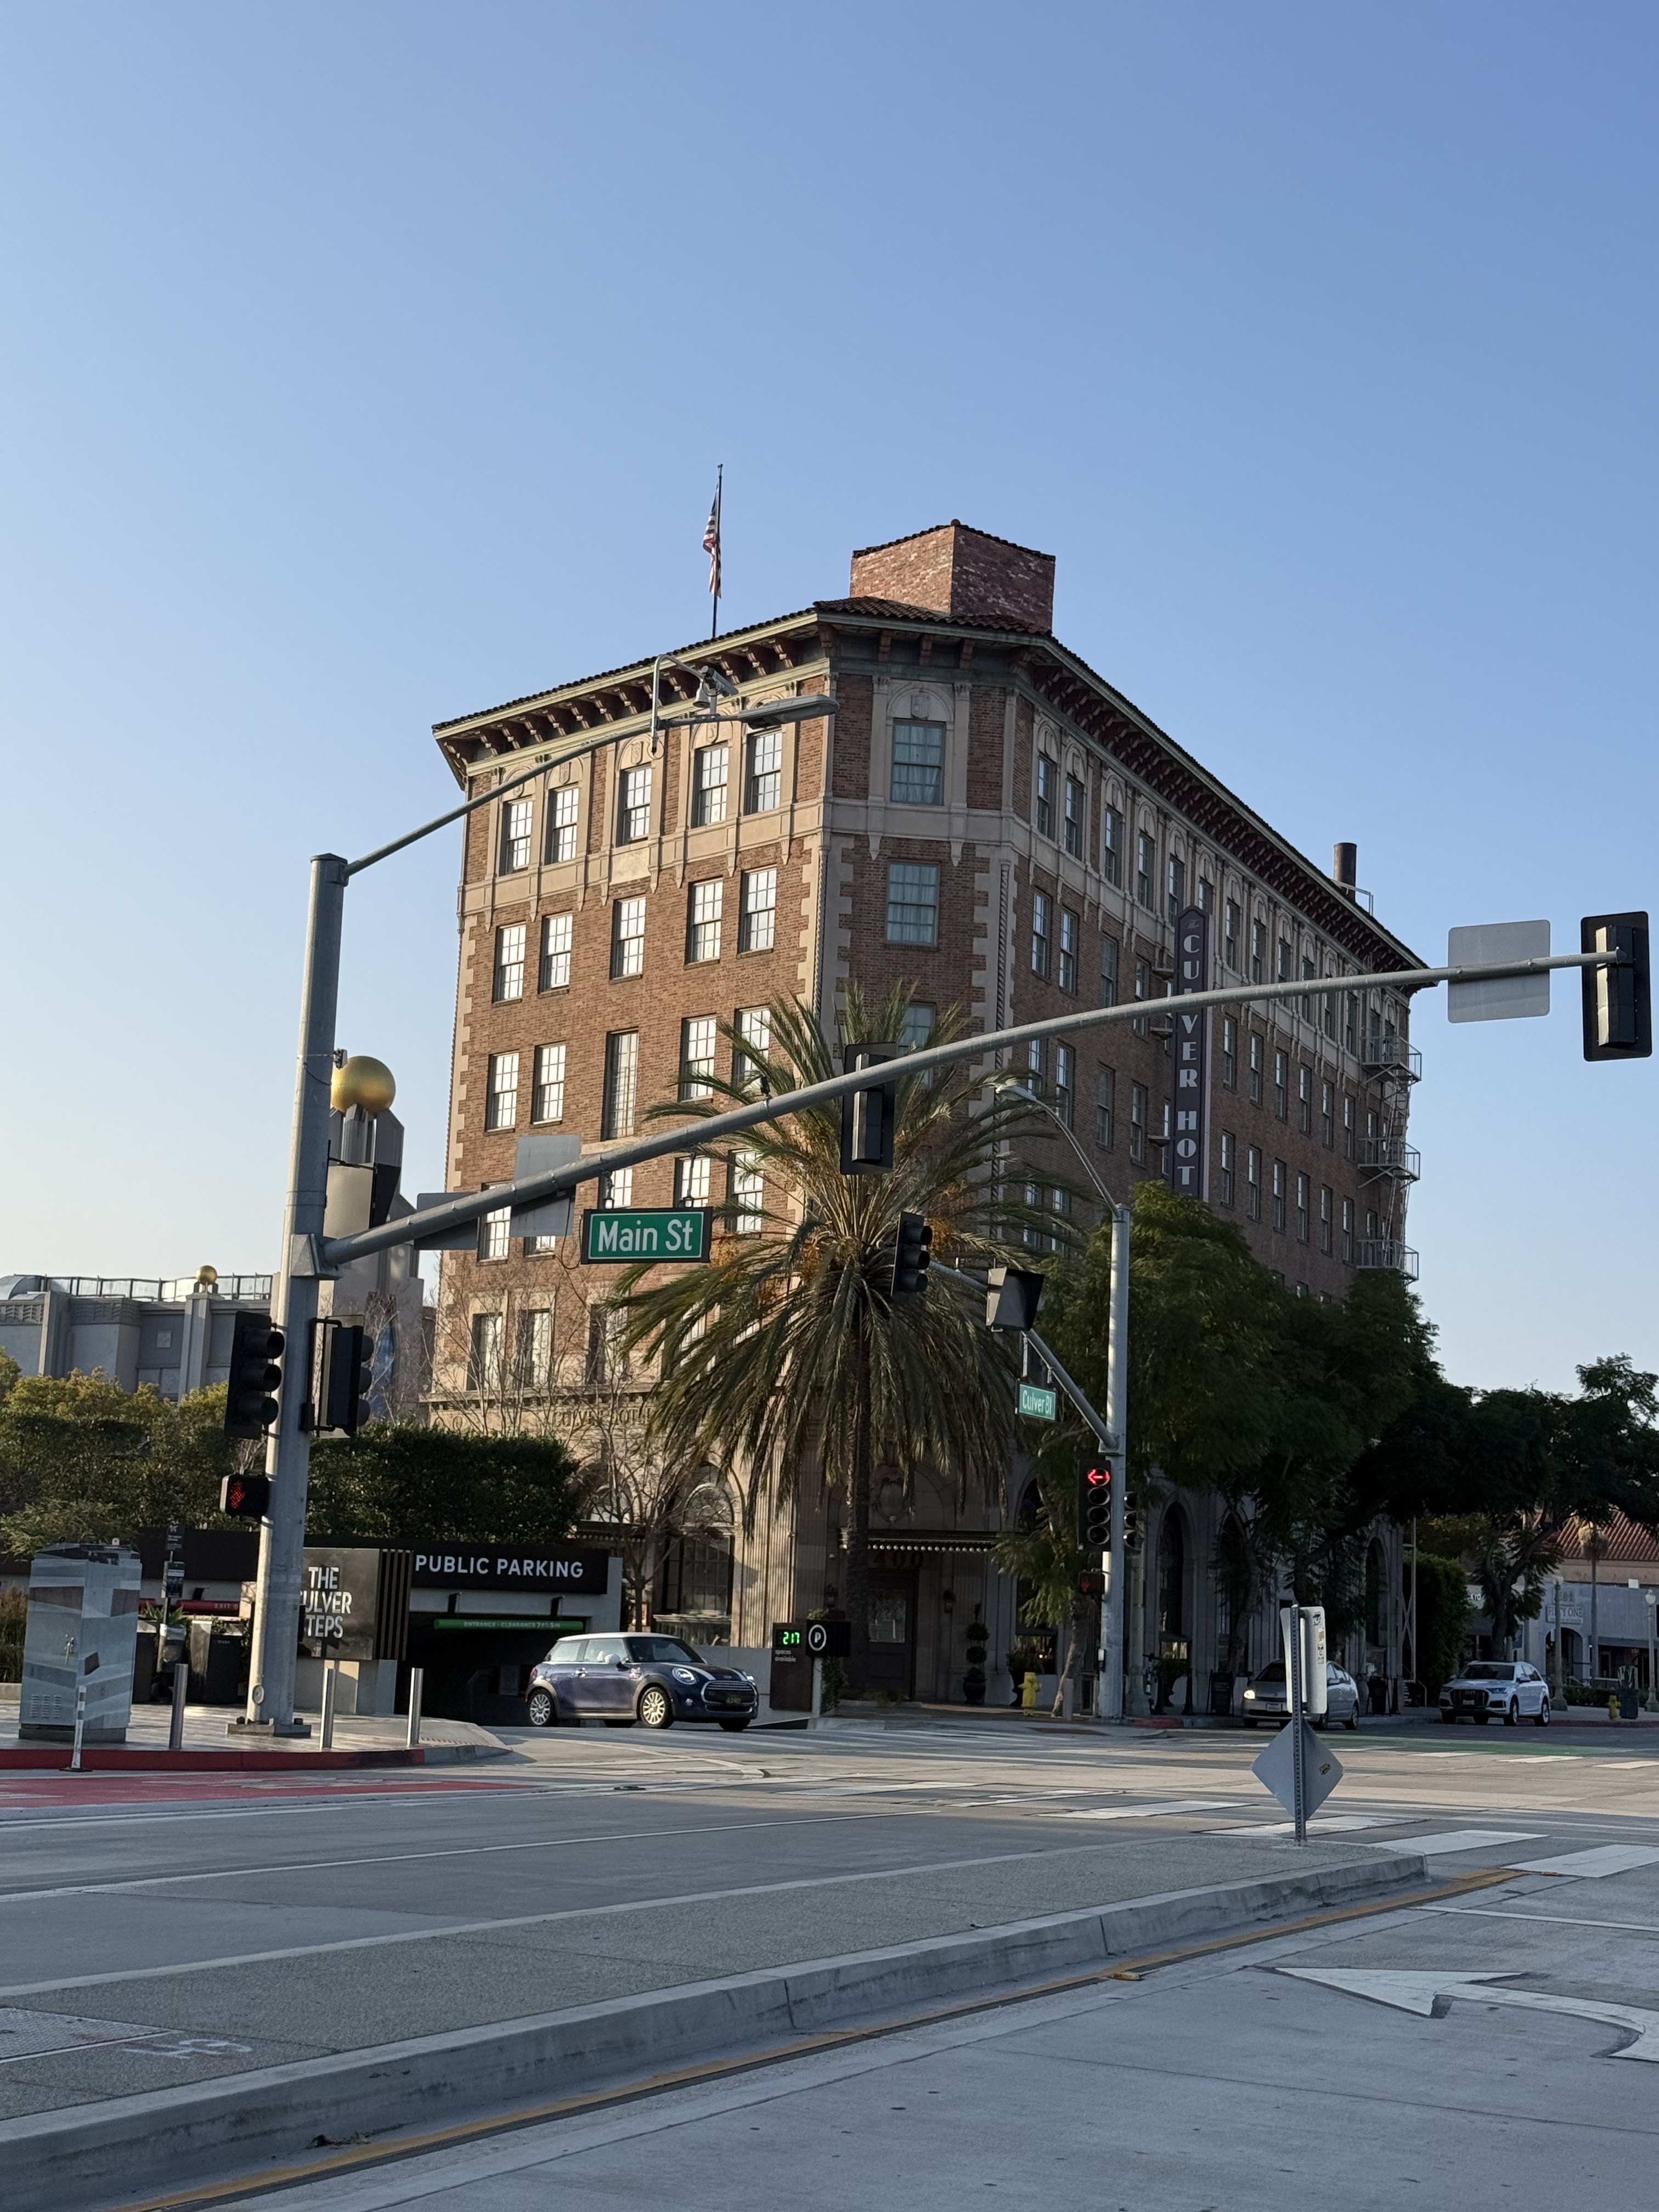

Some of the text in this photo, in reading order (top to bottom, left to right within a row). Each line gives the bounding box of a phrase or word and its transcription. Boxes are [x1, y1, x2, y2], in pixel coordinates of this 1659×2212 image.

[1186, 918, 1200, 930] The
[1176, 934, 1200, 1195] CUVER HOT
[597, 1218, 693, 1252] Main St
[1023, 1390, 1052, 1415] Culver Bl
[308, 1566, 340, 1589] THE
[415, 1554, 584, 1578] PUBLIC PARKING
[300, 1590, 352, 1614] ULVER
[1567, 1607, 1583, 1618] ONE
[305, 1614, 343, 1639] TEPS
[782, 1631, 800, 1645] 217
